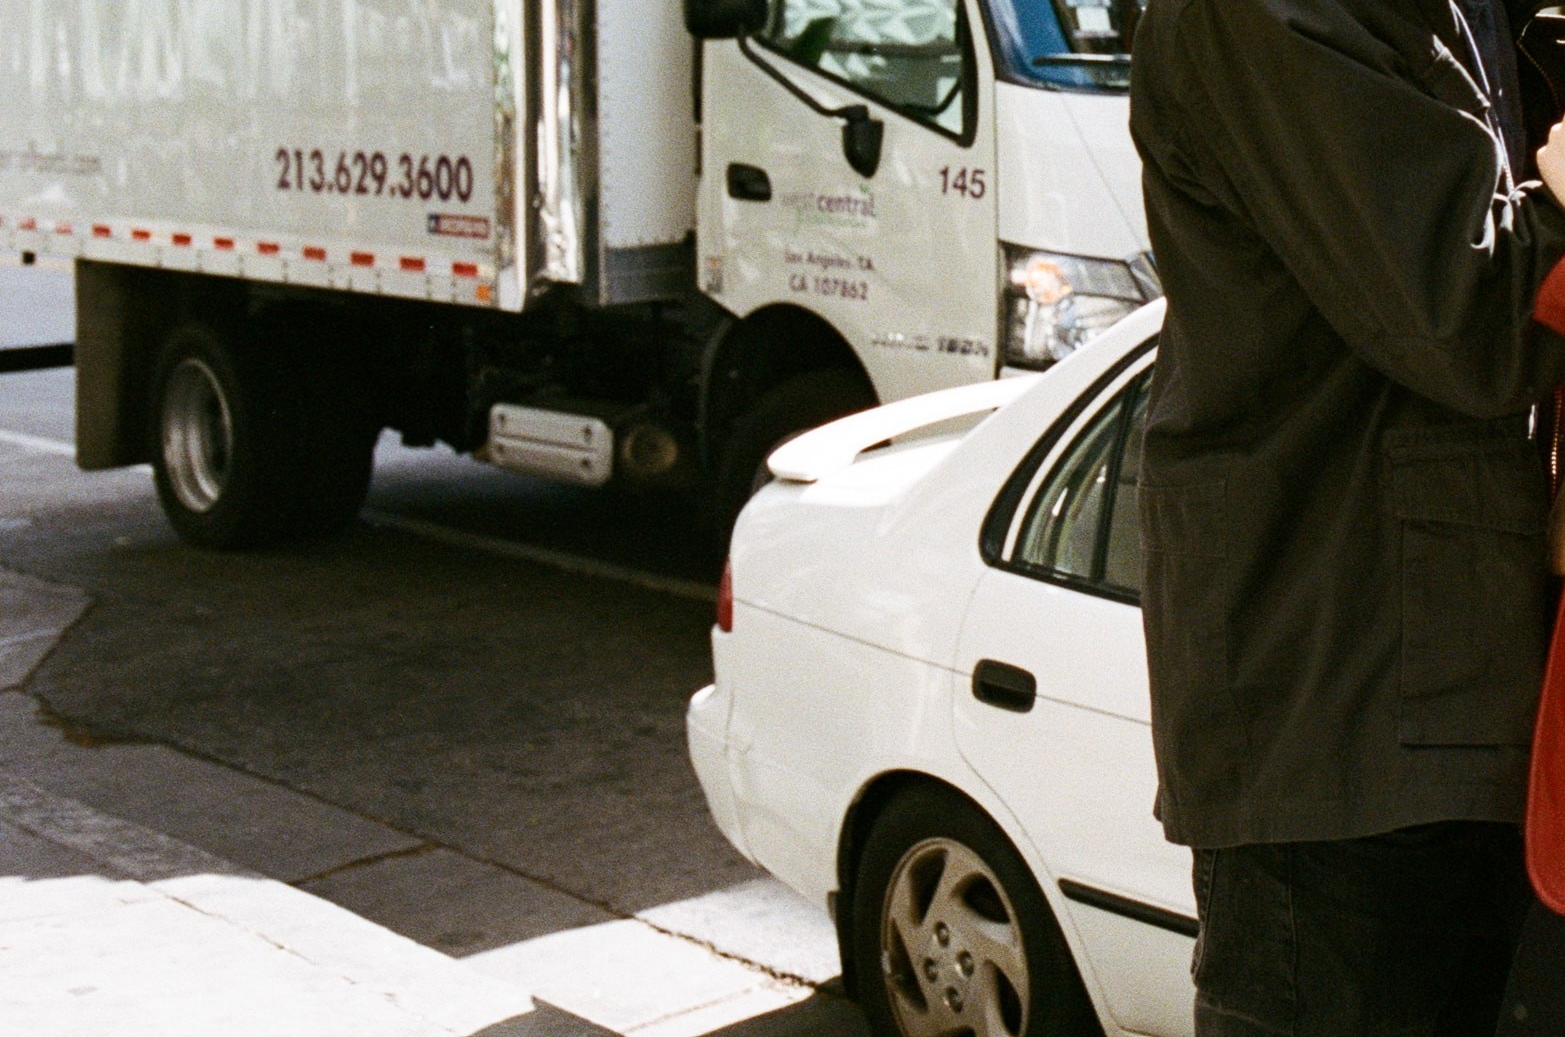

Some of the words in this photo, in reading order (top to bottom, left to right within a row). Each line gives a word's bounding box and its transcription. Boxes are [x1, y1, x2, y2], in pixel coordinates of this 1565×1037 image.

[276, 148, 473, 203] 213.629.3600
[940, 166, 985, 200] 145
[789, 274, 808, 292] CA
